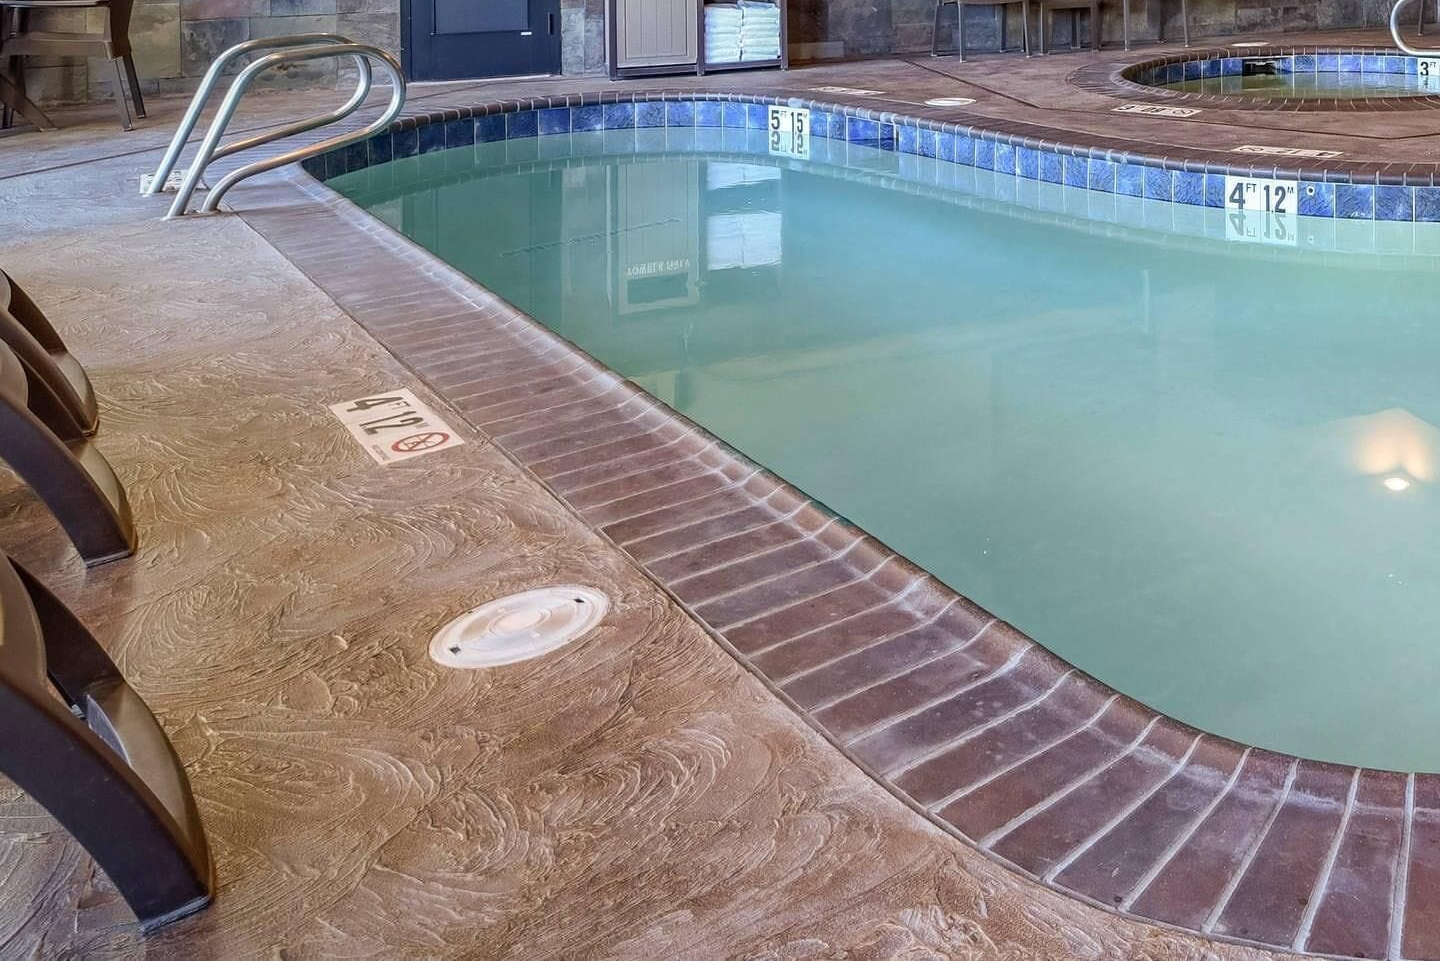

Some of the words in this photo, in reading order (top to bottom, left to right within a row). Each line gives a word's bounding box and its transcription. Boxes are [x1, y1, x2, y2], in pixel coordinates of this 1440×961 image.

[1420, 62, 1428, 76] 3
[771, 110, 780, 130] 5
[1229, 182, 1246, 209] 4
[1246, 183, 1256, 193] FT
[346, 396, 404, 412] 4
